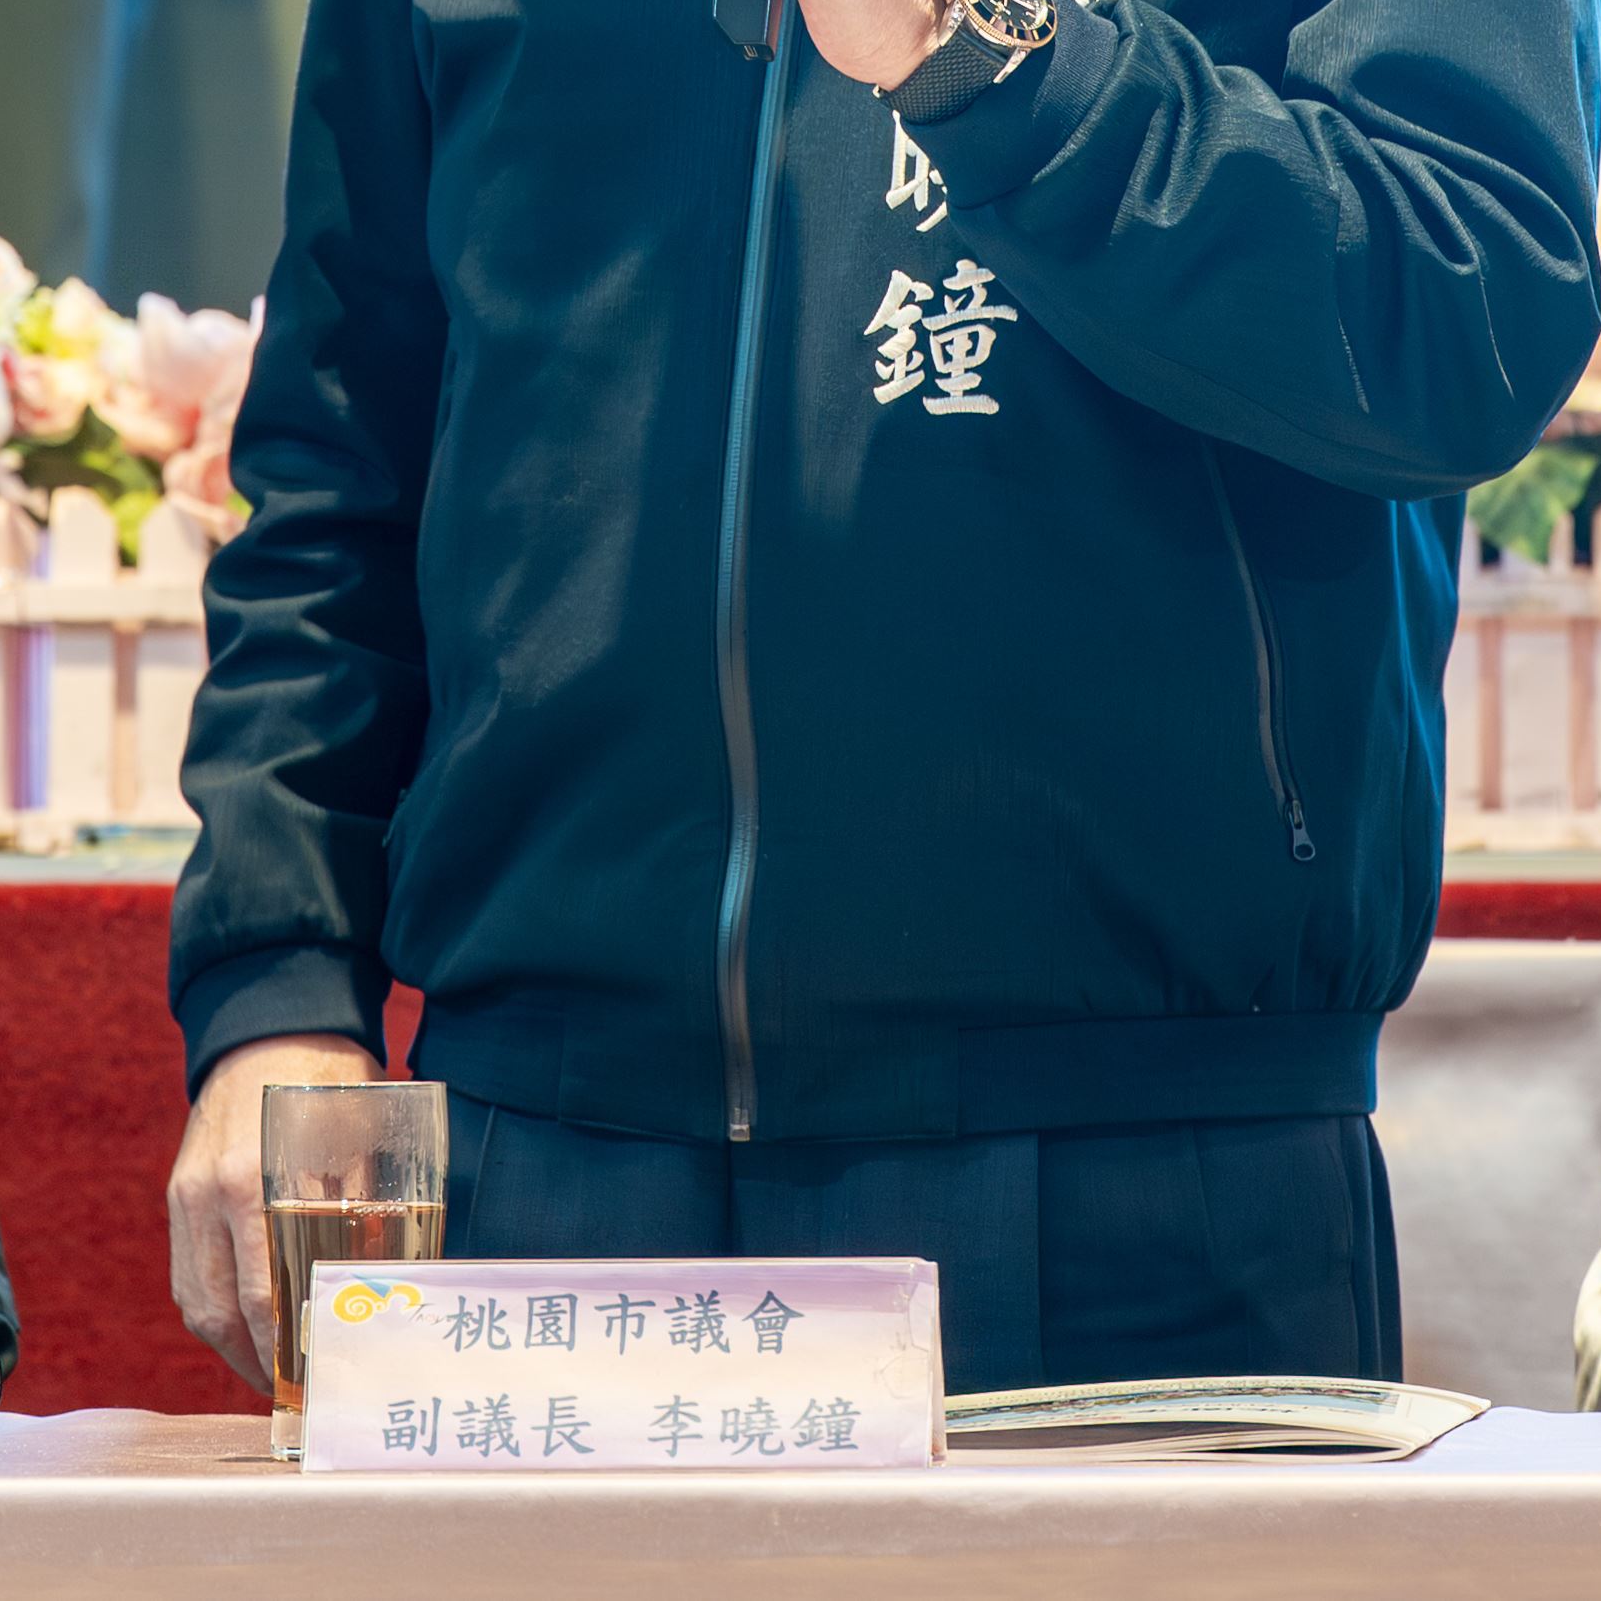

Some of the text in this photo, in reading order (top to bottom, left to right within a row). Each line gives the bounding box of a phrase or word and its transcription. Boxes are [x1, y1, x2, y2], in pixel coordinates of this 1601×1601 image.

[443, 1290, 805, 1356] 桃園市議會
[382, 1394, 862, 1458] 副議長 李曉鐘
